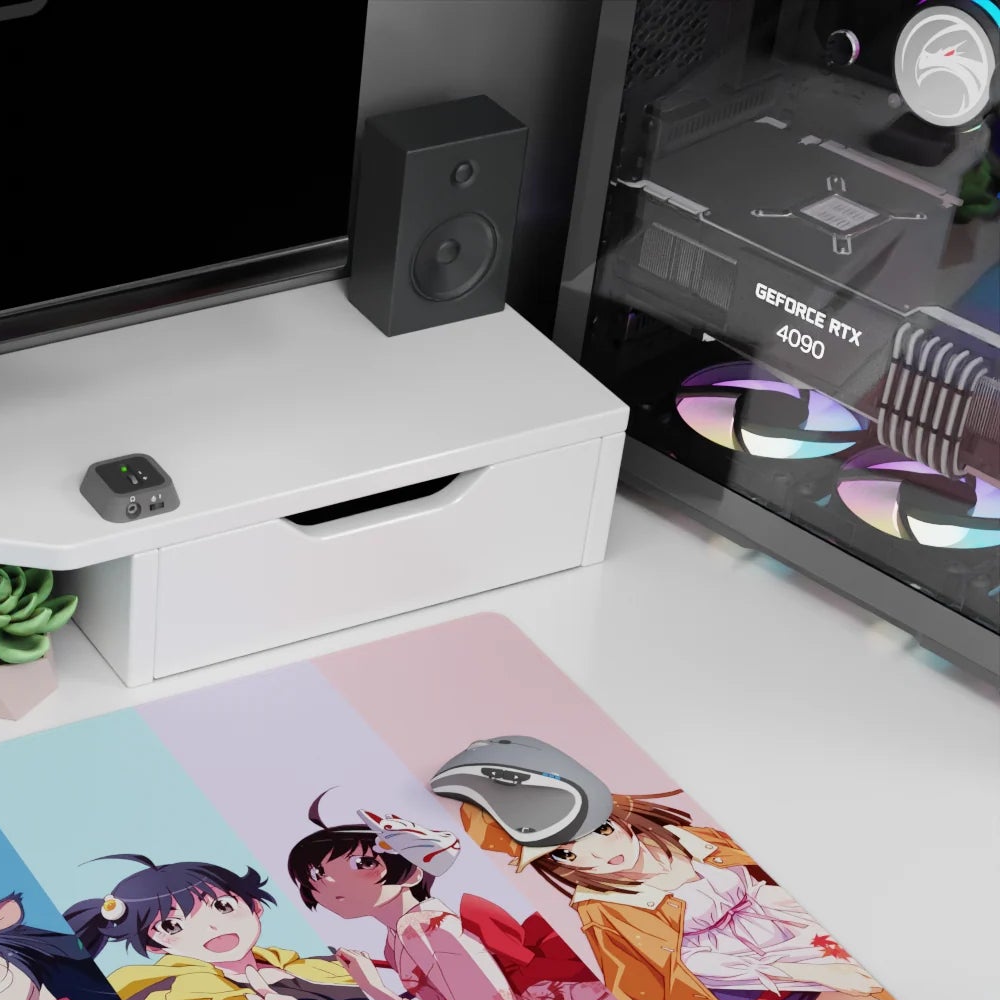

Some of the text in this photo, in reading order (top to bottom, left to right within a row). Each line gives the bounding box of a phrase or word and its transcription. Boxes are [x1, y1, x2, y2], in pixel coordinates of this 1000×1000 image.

[755, 283, 863, 347] GEFORCE RTX
[776, 325, 825, 359] 4090
